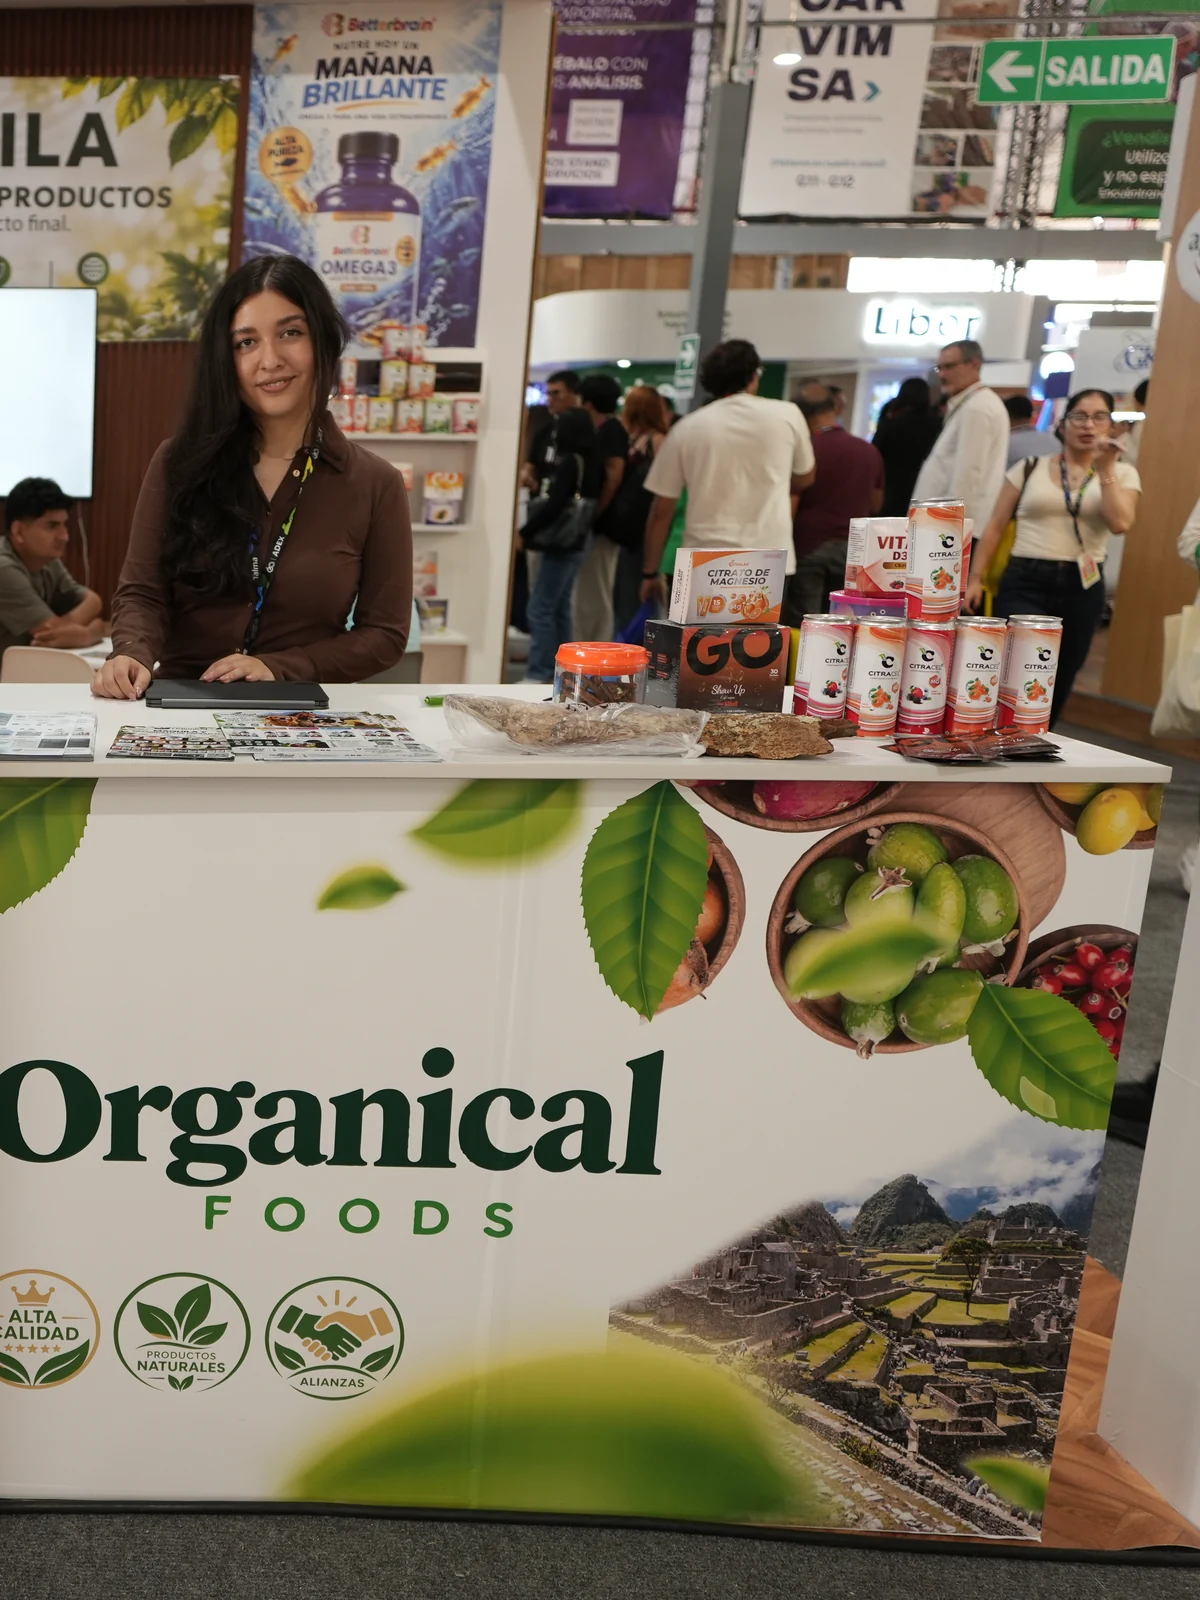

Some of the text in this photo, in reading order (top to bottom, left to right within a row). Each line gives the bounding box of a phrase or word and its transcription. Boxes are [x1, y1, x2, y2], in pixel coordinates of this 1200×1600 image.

[315, 52, 434, 80] MAÑANA
[1045, 53, 1166, 87] SALIDA
[787, 67, 856, 102] SA
[302, 78, 448, 109] BRILLANTE
[27, 213, 71, 232] final.
[272, 535, 285, 558] ADEX
[877, 536, 908, 550] VIT
[707, 568, 771, 578] CITRATO DE
[709, 577, 766, 586] MAGNESIO
[686, 628, 784, 677] GO
[733, 684, 746, 696] Up
[204, 1194, 515, 1239] FOODS
[8, 1309, 58, 1325] ALTA
[146, 1350, 217, 1361] PRODUCTOS
[137, 1361, 226, 1374] NATURALES
[300, 1376, 366, 1389] ALIANZAS
